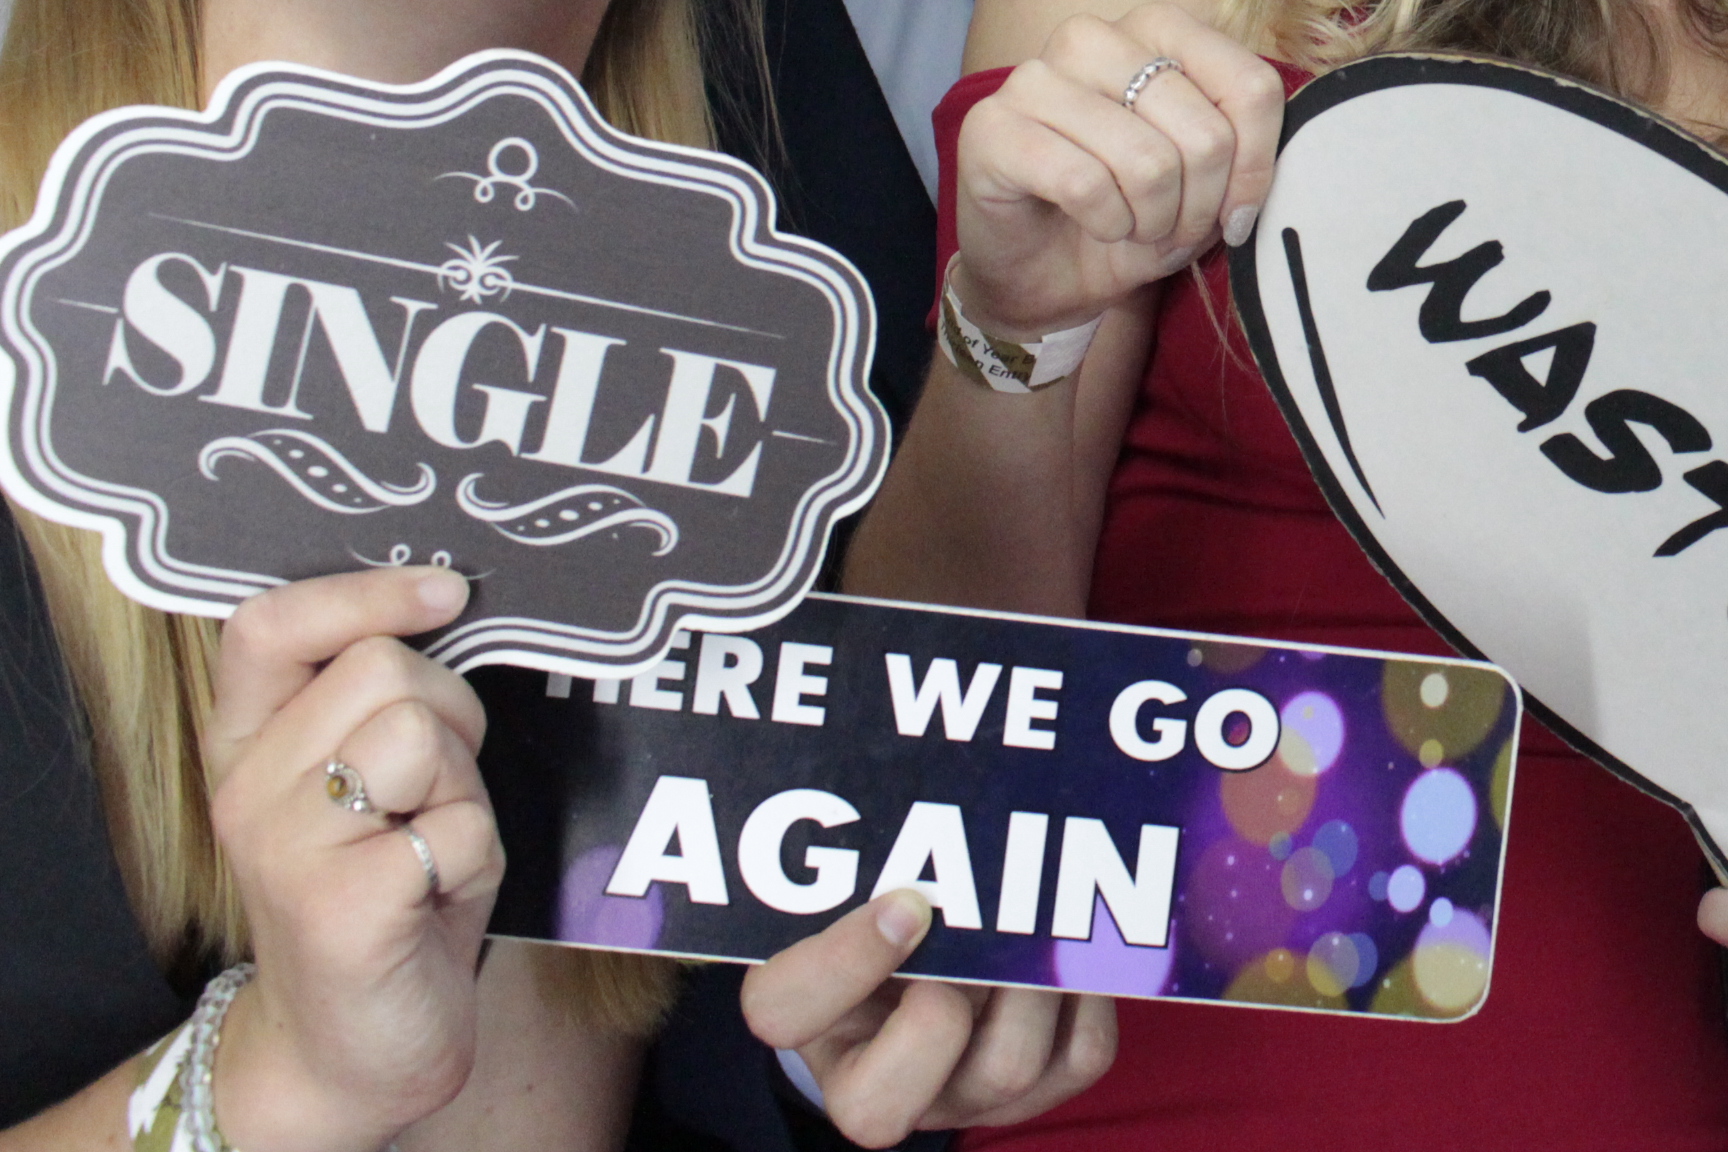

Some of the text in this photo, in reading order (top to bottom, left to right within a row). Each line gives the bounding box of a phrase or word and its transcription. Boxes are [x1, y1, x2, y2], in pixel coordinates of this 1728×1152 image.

[103, 253, 777, 498] SINGLE
[885, 651, 1064, 750] WE
[1108, 679, 1281, 771] GO
[604, 774, 1180, 949] AGAIN
